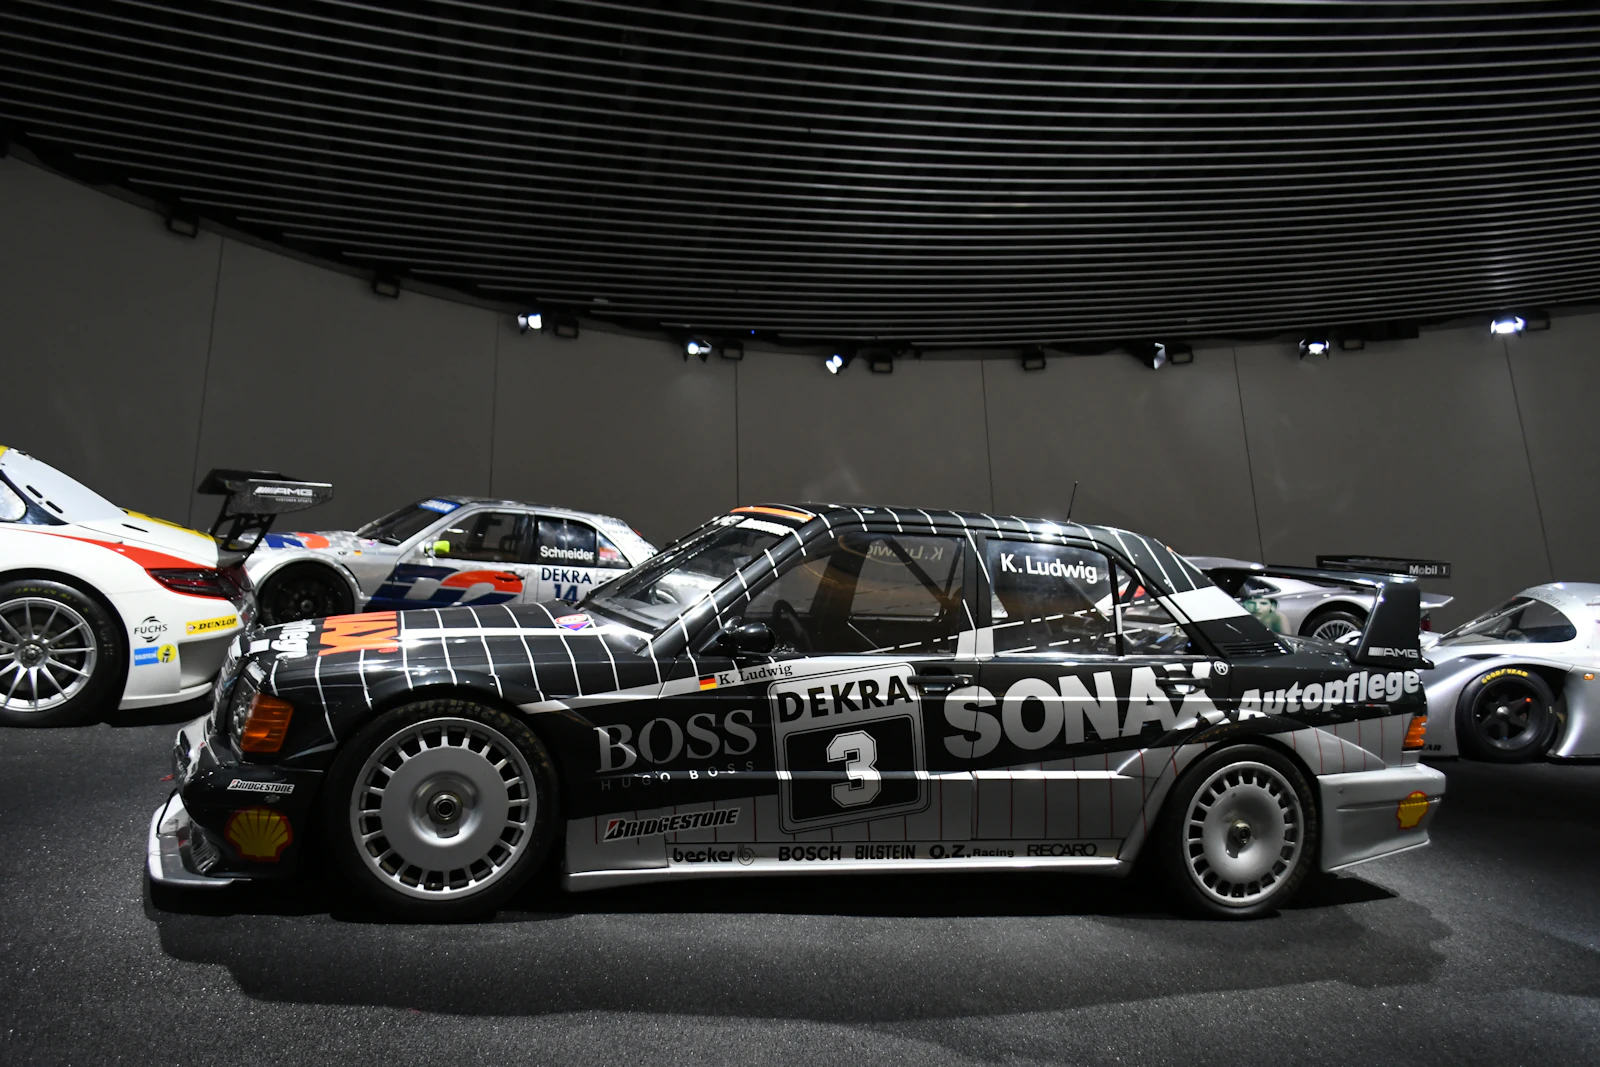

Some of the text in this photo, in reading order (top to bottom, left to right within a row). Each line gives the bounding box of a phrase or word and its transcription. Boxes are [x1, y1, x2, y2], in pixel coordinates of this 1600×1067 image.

[273, 487, 313, 497] AMG
[540, 545, 594, 560] Schneider
[541, 567, 592, 584] DEKRA
[1000, 553, 1098, 584] K. Ludwig
[1409, 565, 1438, 575] Mobil
[554, 584, 579, 603] 14
[134, 624, 168, 635] FUCHS
[198, 618, 237, 630] DUNLOP
[1383, 648, 1419, 659] AMG
[718, 664, 793, 686] K. Ludwig
[776, 675, 914, 723] DEKRA
[1238, 670, 1420, 721] Autopflege
[593, 709, 758, 773] BOSS
[601, 761, 754, 791] HUGO BOSS
[826, 730, 881, 808] 3
[232, 779, 294, 793] BRIDGESTONE
[604, 808, 739, 840] BRIDGESTONE
[673, 847, 735, 863] becker
[778, 846, 842, 862] BOSCH
[855, 844, 916, 860] BILSTEIN
[929, 844, 1015, 860] O.Z. Racing
[1027, 843, 1097, 857] RECARO
